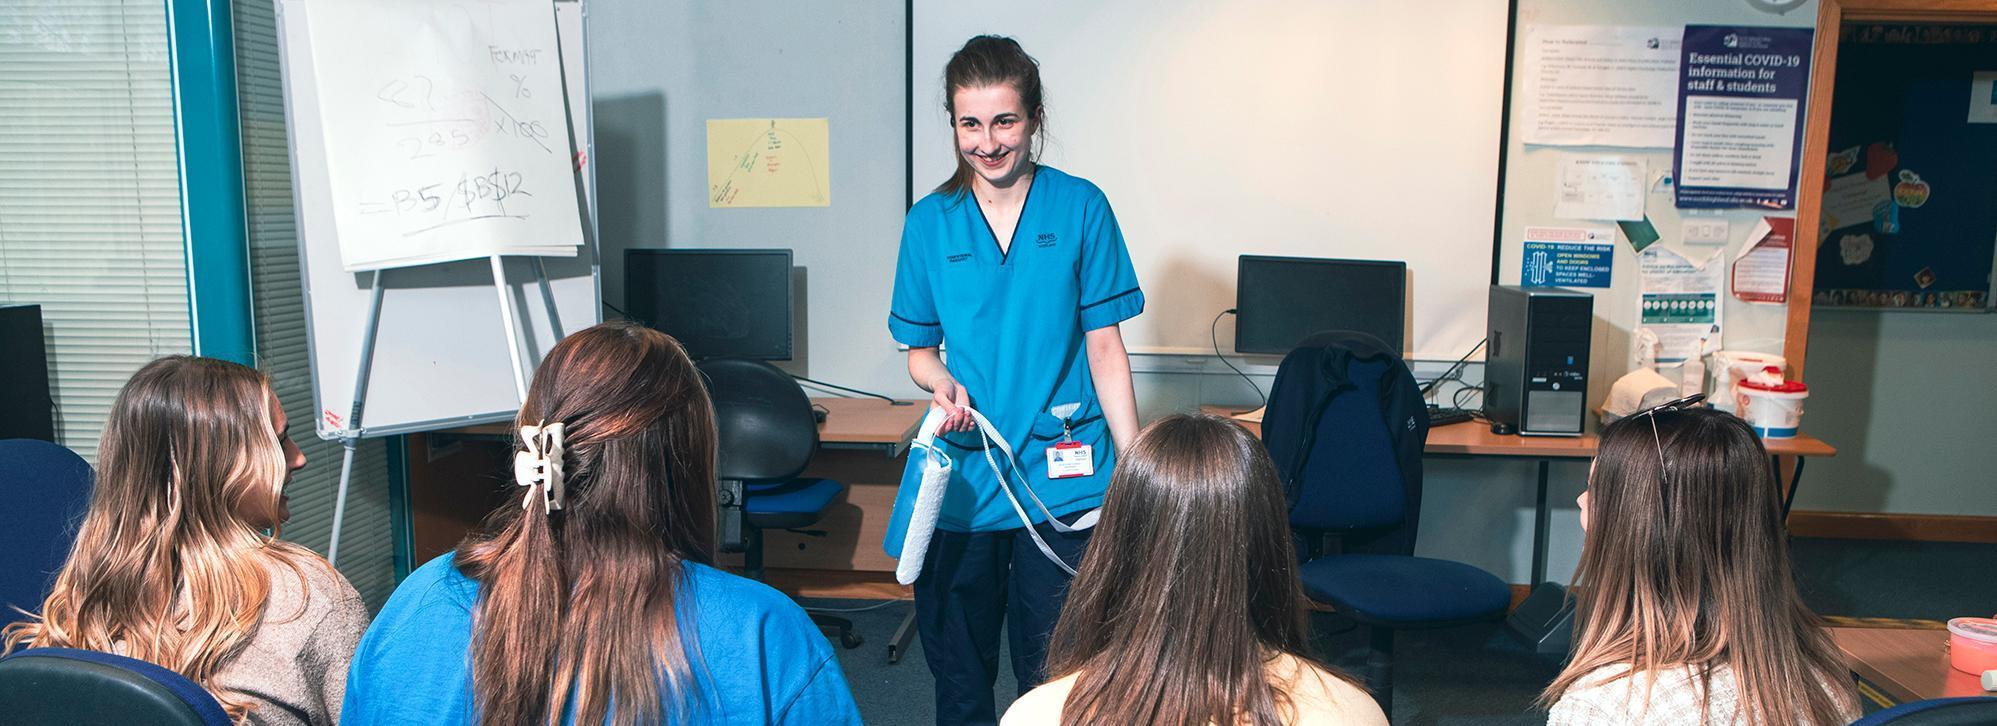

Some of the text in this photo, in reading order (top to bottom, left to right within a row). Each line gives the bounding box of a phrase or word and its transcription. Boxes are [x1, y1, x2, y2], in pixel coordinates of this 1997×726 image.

[1689, 52, 1742, 65] Essential
[1744, 54, 1800, 67] COVID-19
[1688, 66, 1755, 79] information
[1758, 67, 1776, 80] for
[1687, 79, 1776, 93] staff & students
[1038, 232, 1056, 241] NHS
